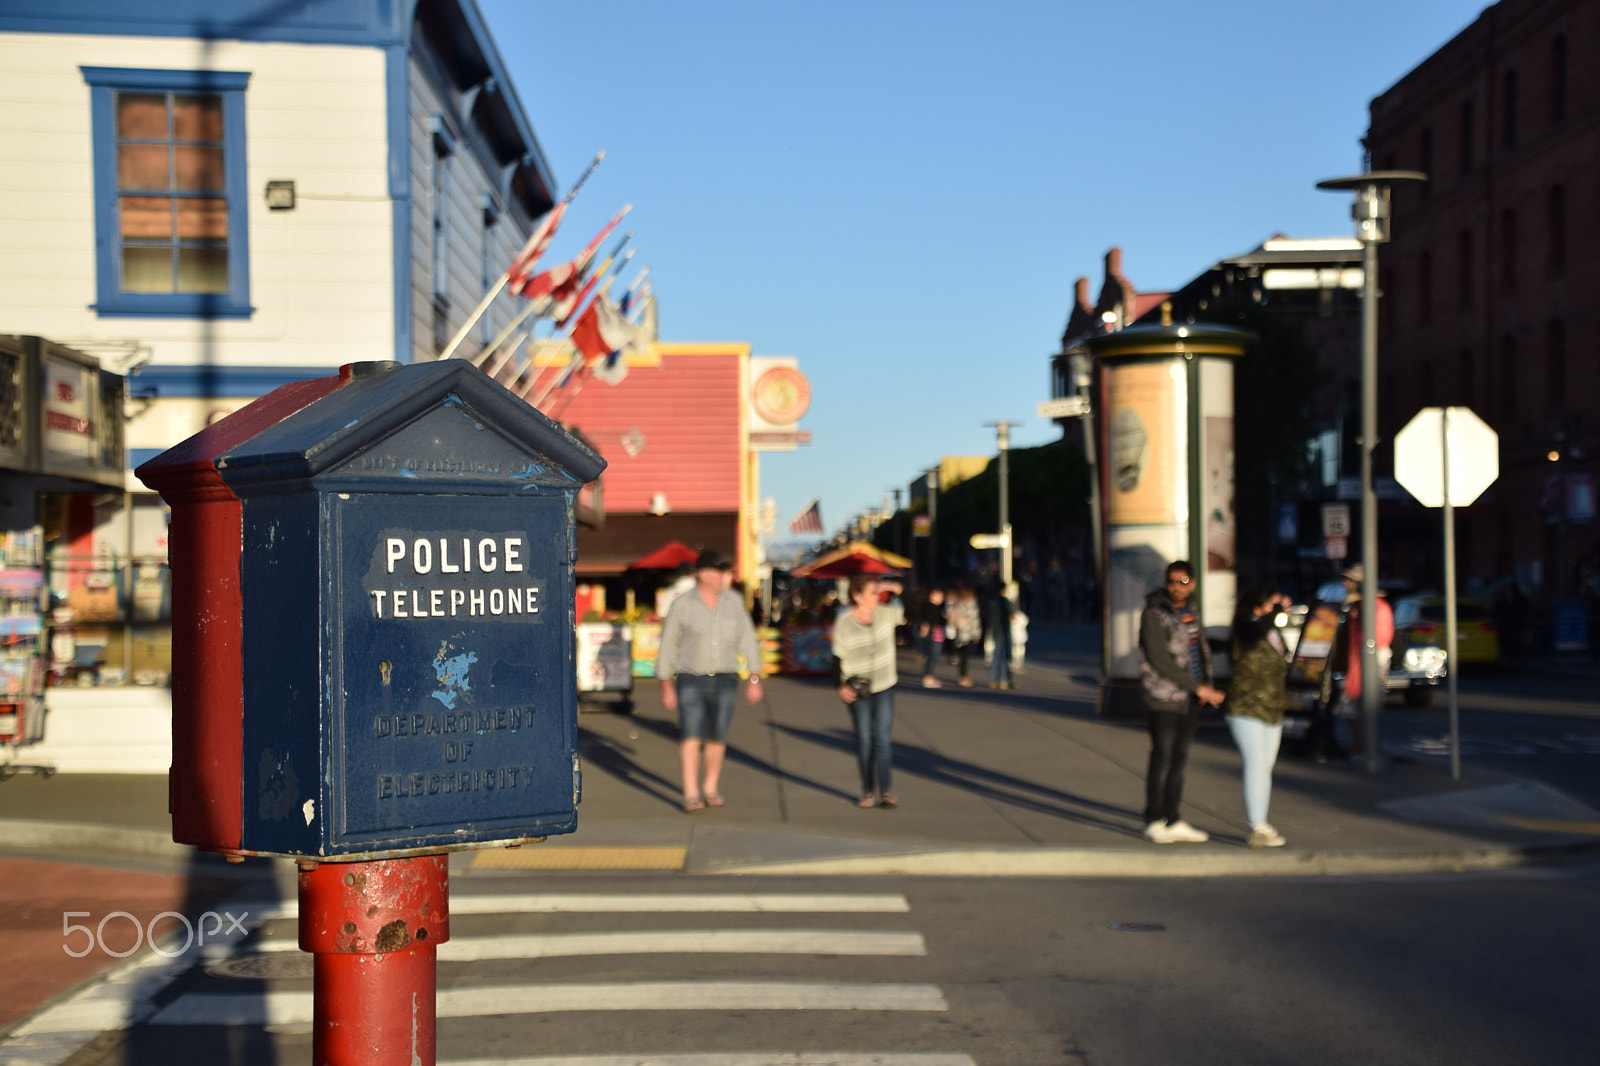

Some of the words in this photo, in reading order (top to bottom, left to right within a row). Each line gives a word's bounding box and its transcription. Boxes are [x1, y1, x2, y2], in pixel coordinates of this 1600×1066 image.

[386, 538, 523, 574] POLICE
[370, 587, 540, 619] TELEPHONE
[375, 706, 536, 738] DEPARTMENT
[444, 740, 474, 763] OF
[377, 766, 536, 800] ELECTRICITY
